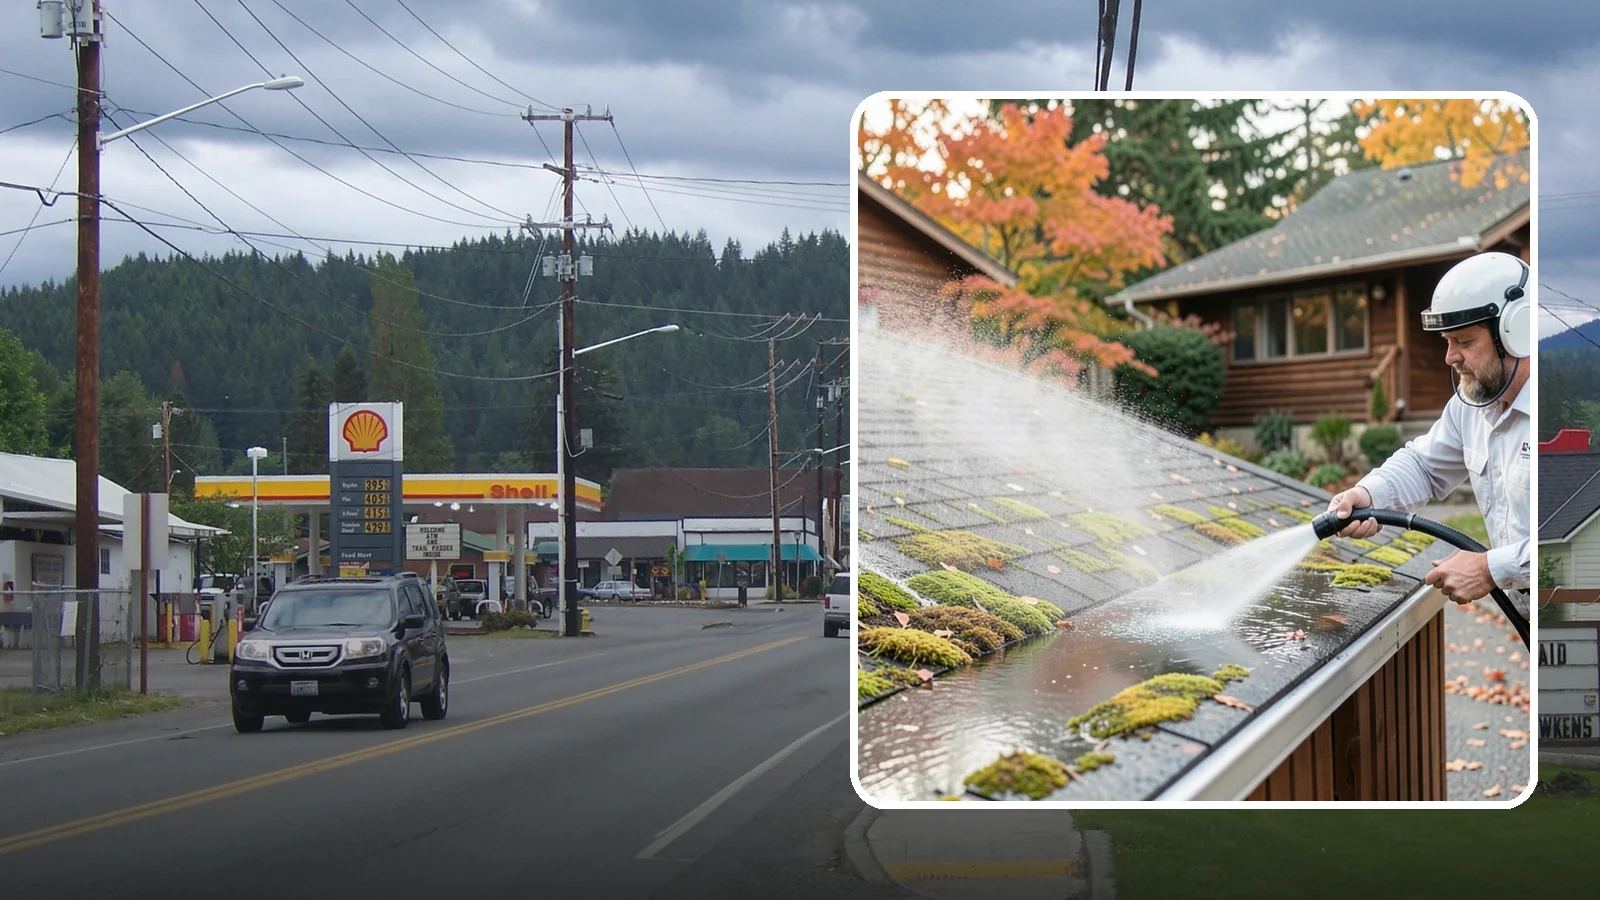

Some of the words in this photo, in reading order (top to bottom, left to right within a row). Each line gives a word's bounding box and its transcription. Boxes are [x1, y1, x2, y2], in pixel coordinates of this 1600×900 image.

[366, 480, 383, 490] 395
[490, 484, 547, 499] Shell
[366, 494, 383, 504] 405
[366, 508, 383, 518] 415
[366, 522, 383, 532] 429
